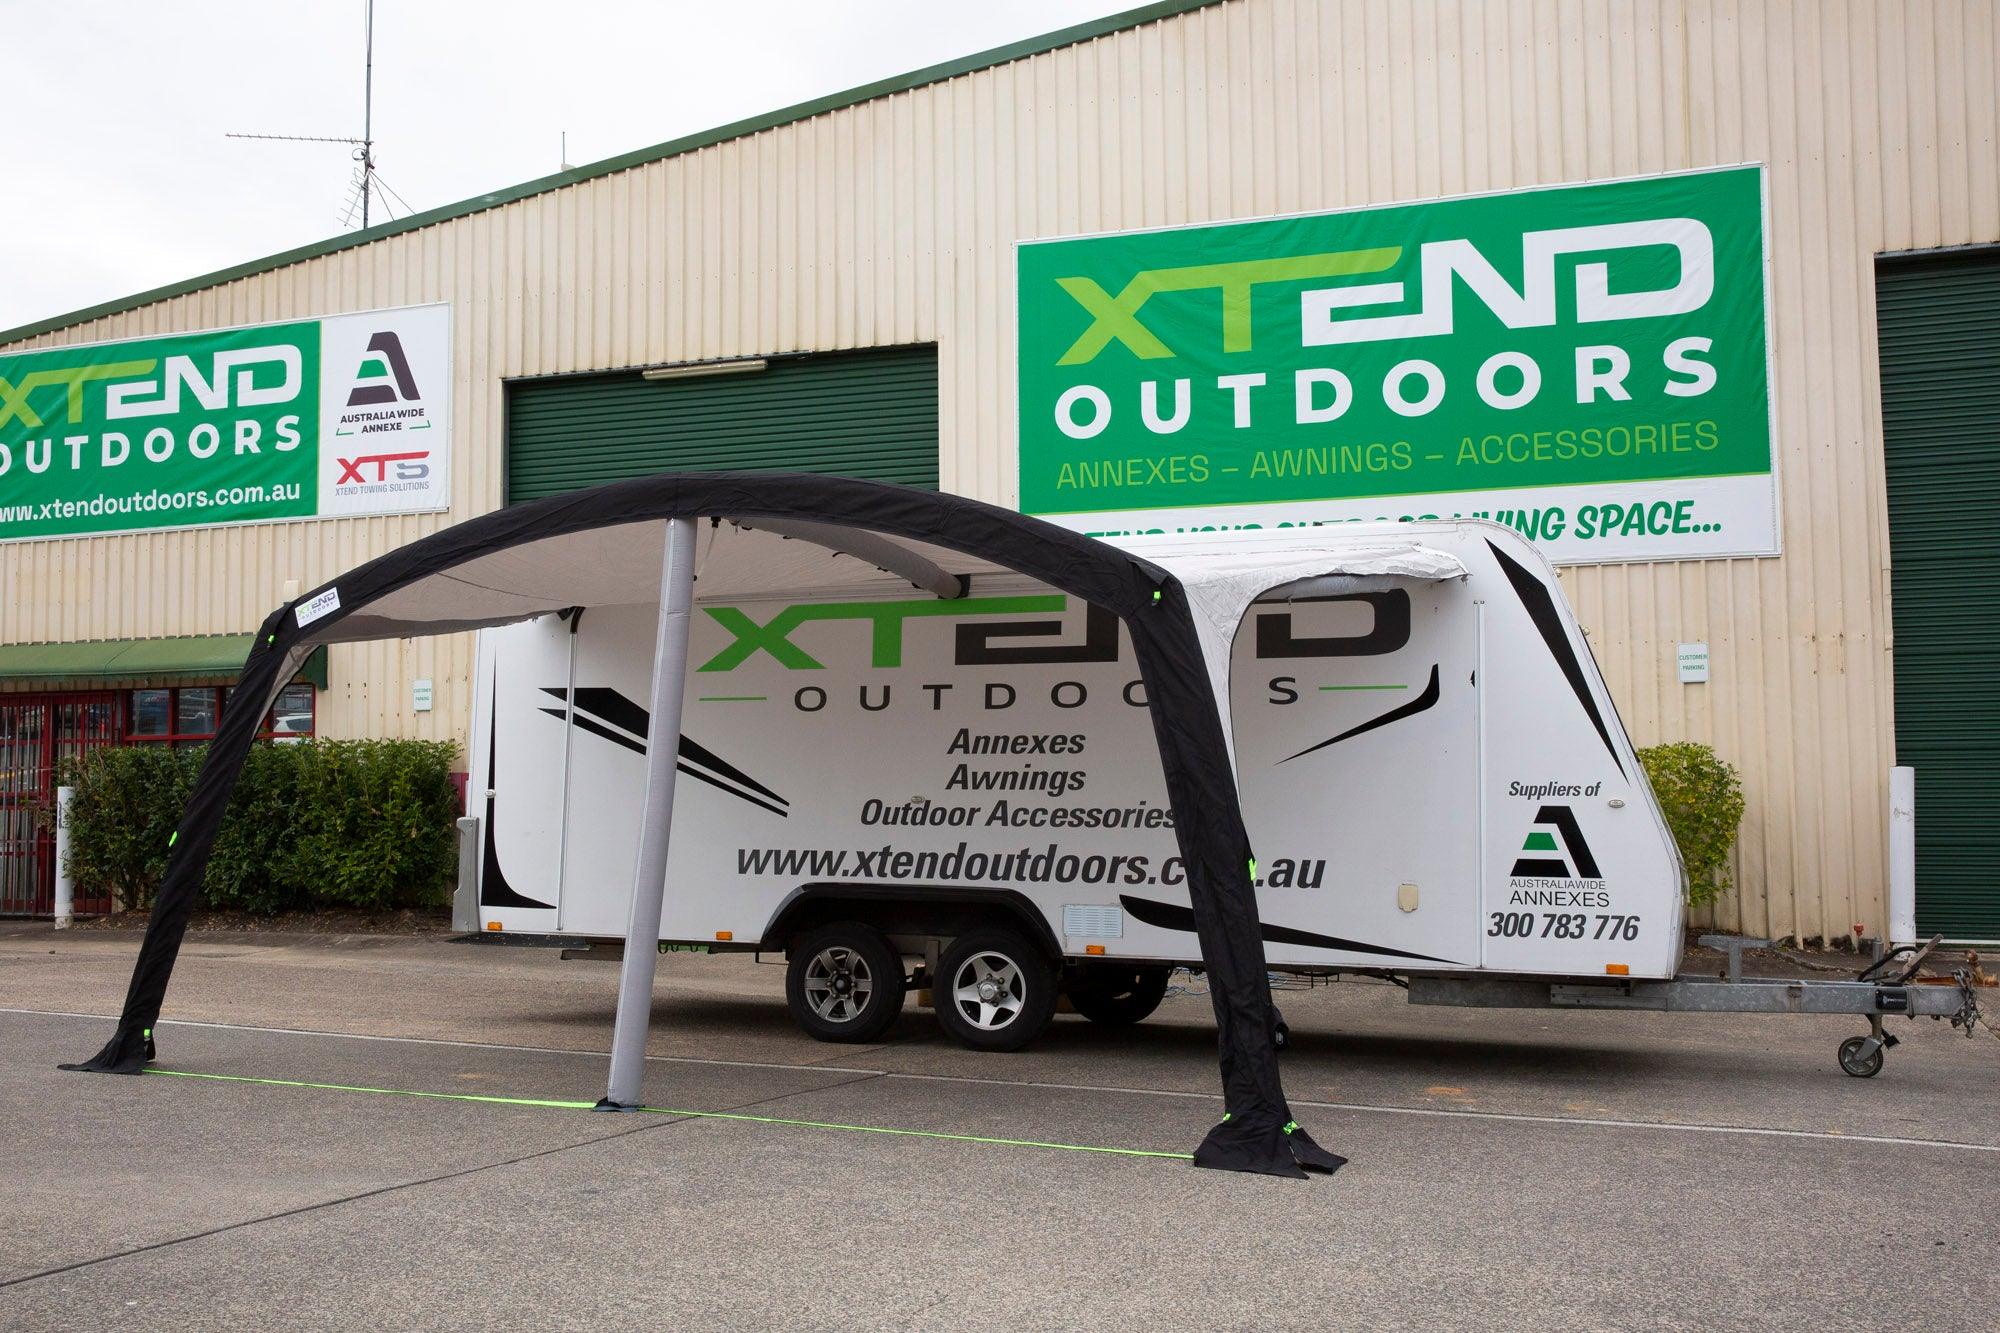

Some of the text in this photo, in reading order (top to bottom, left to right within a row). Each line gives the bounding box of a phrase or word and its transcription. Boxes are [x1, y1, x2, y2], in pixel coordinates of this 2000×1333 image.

[1055, 218, 1715, 366] XTEND
[0, 344, 303, 428] XTEND
[1054, 337, 1717, 439] OUTDOORS
[361, 422, 402, 434] ANNEXE
[336, 450, 430, 485] XTS
[1056, 455, 1209, 490] ANNEXES
[1250, 442, 1412, 479] AWNINGS
[1456, 420, 1719, 465] ACCESSORIES
[335, 481, 430, 497] XTEND TOWING SOLUTIONS
[1574, 500, 1722, 540] SPACE...
[696, 588, 1411, 673] XTED
[793, 676, 1299, 713] OUTDOOS
[945, 728, 1087, 755] Annexes
[944, 763, 1087, 798] Awnings
[1508, 780, 1602, 801] Suppliers of
[860, 799, 982, 827] Outdoor
[737, 842, 1327, 889] www.xtendoutdoors.c.au
[1509, 878, 1606, 890] AUSTRALIAWIDE
[1509, 889, 1610, 908] ANNEXES
[1487, 911, 1641, 942] 300 783 776
